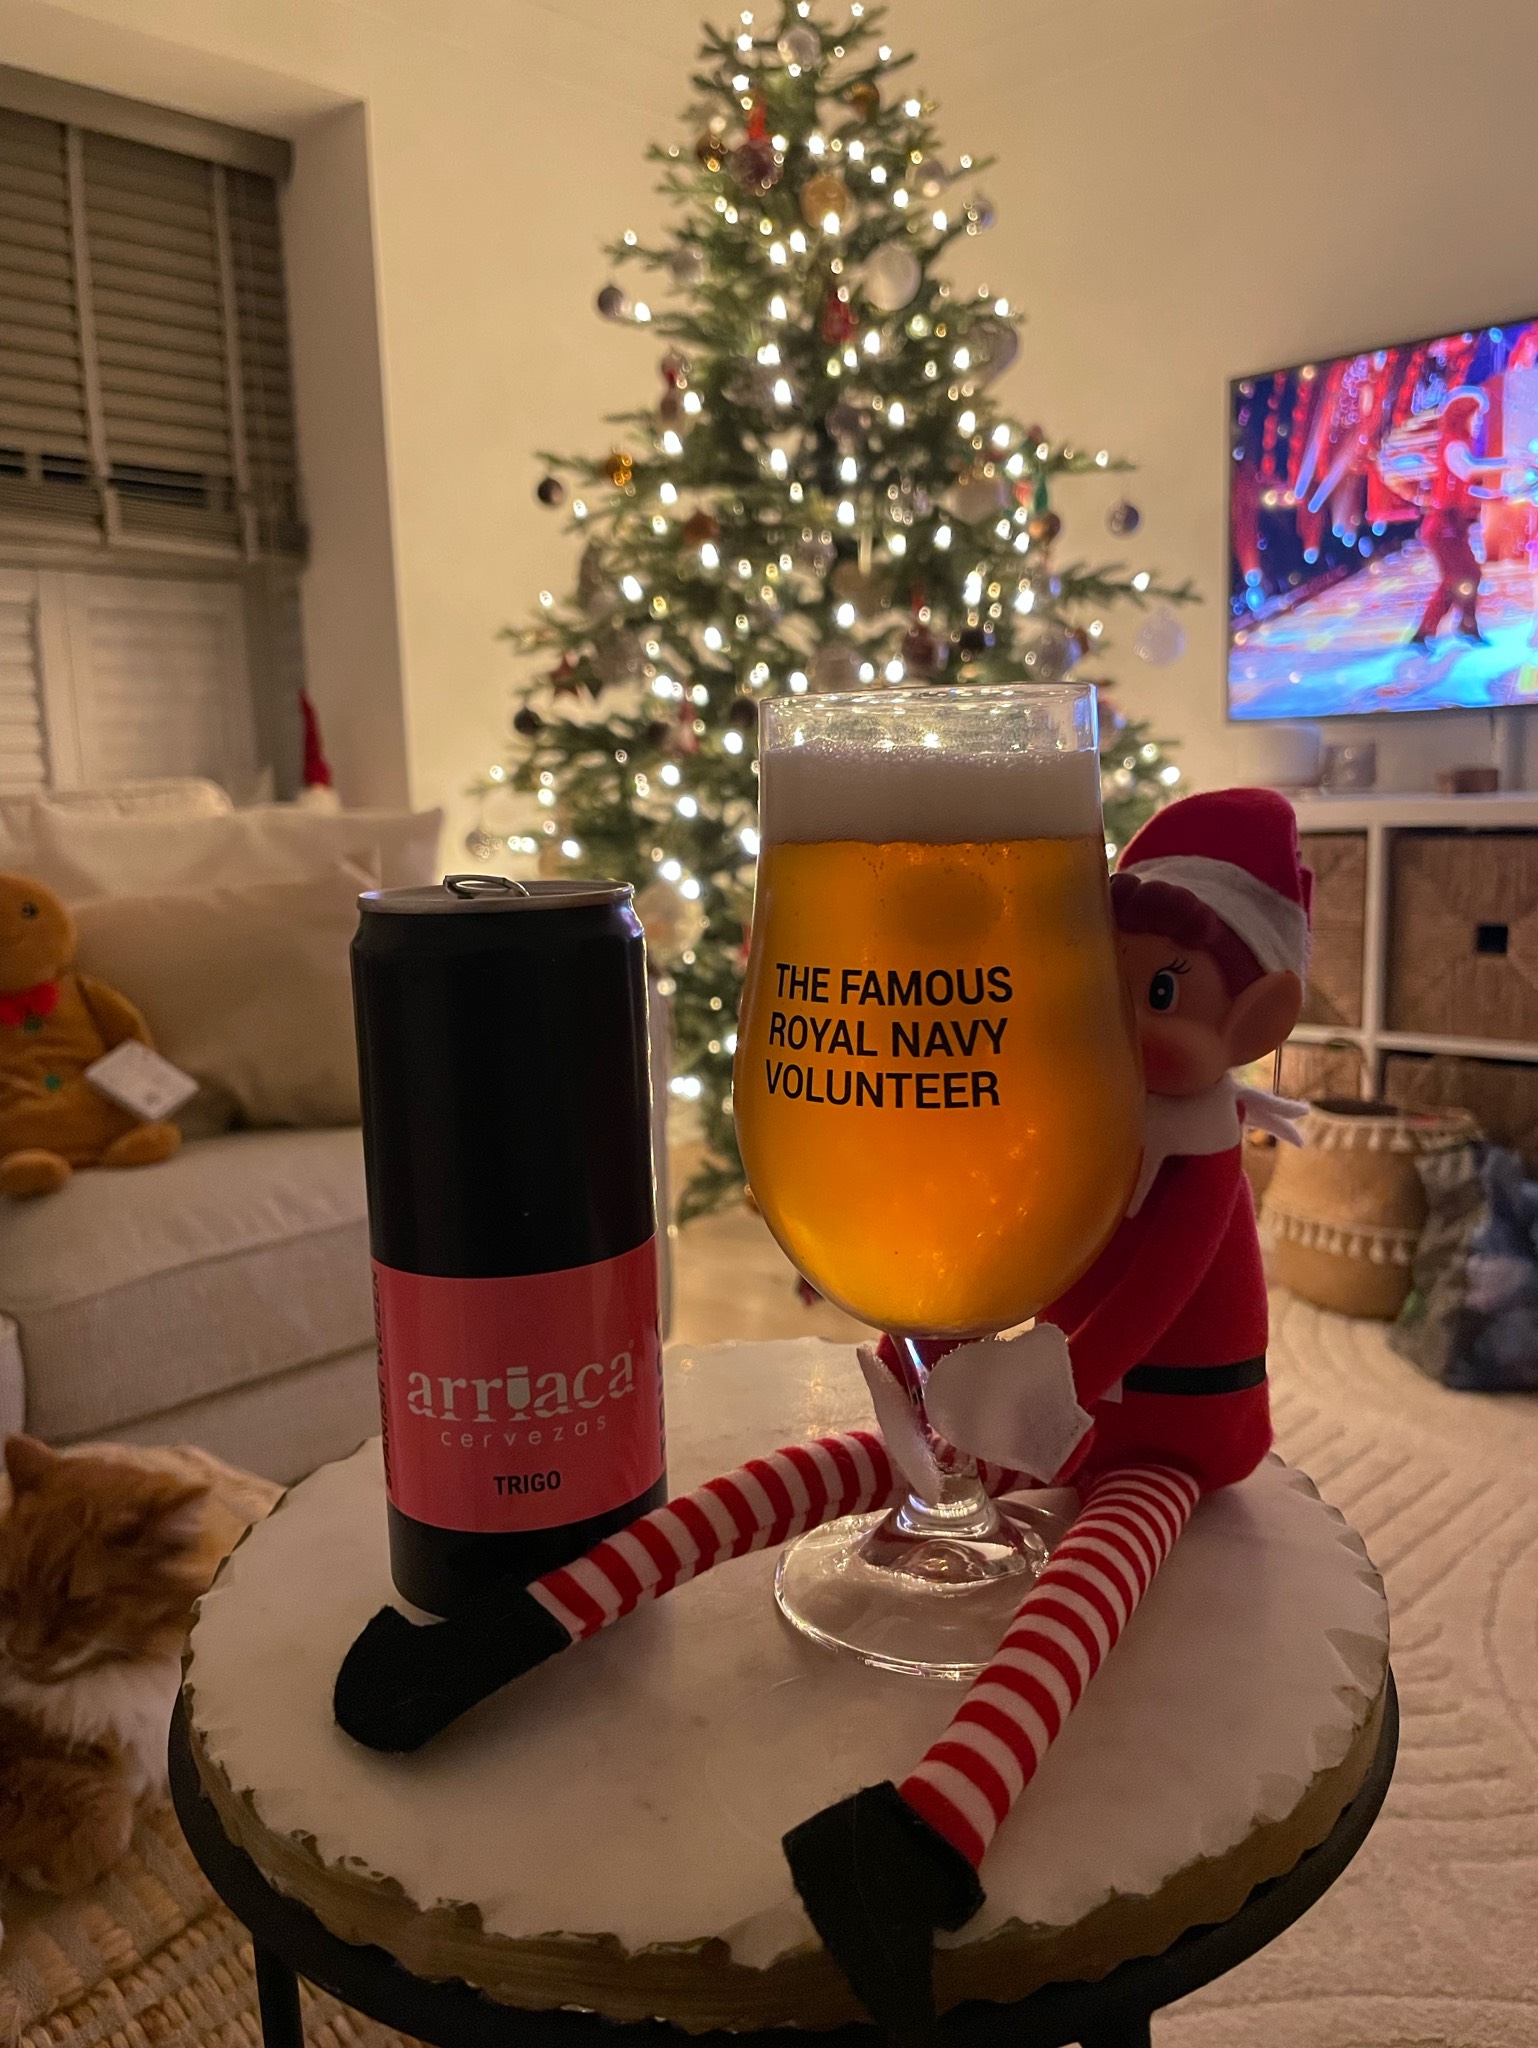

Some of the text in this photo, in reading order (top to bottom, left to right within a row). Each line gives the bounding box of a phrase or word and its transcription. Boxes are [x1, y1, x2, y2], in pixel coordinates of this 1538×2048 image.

[776, 963, 1013, 1006] THE FAMOUS
[769, 1012, 1008, 1057] ROYAL NAVY
[766, 1059, 1000, 1108] VOLUNTEER
[407, 1350, 636, 1422] arriaca
[441, 1415, 606, 1448] cervezas
[493, 1471, 561, 1495] TRIGO
